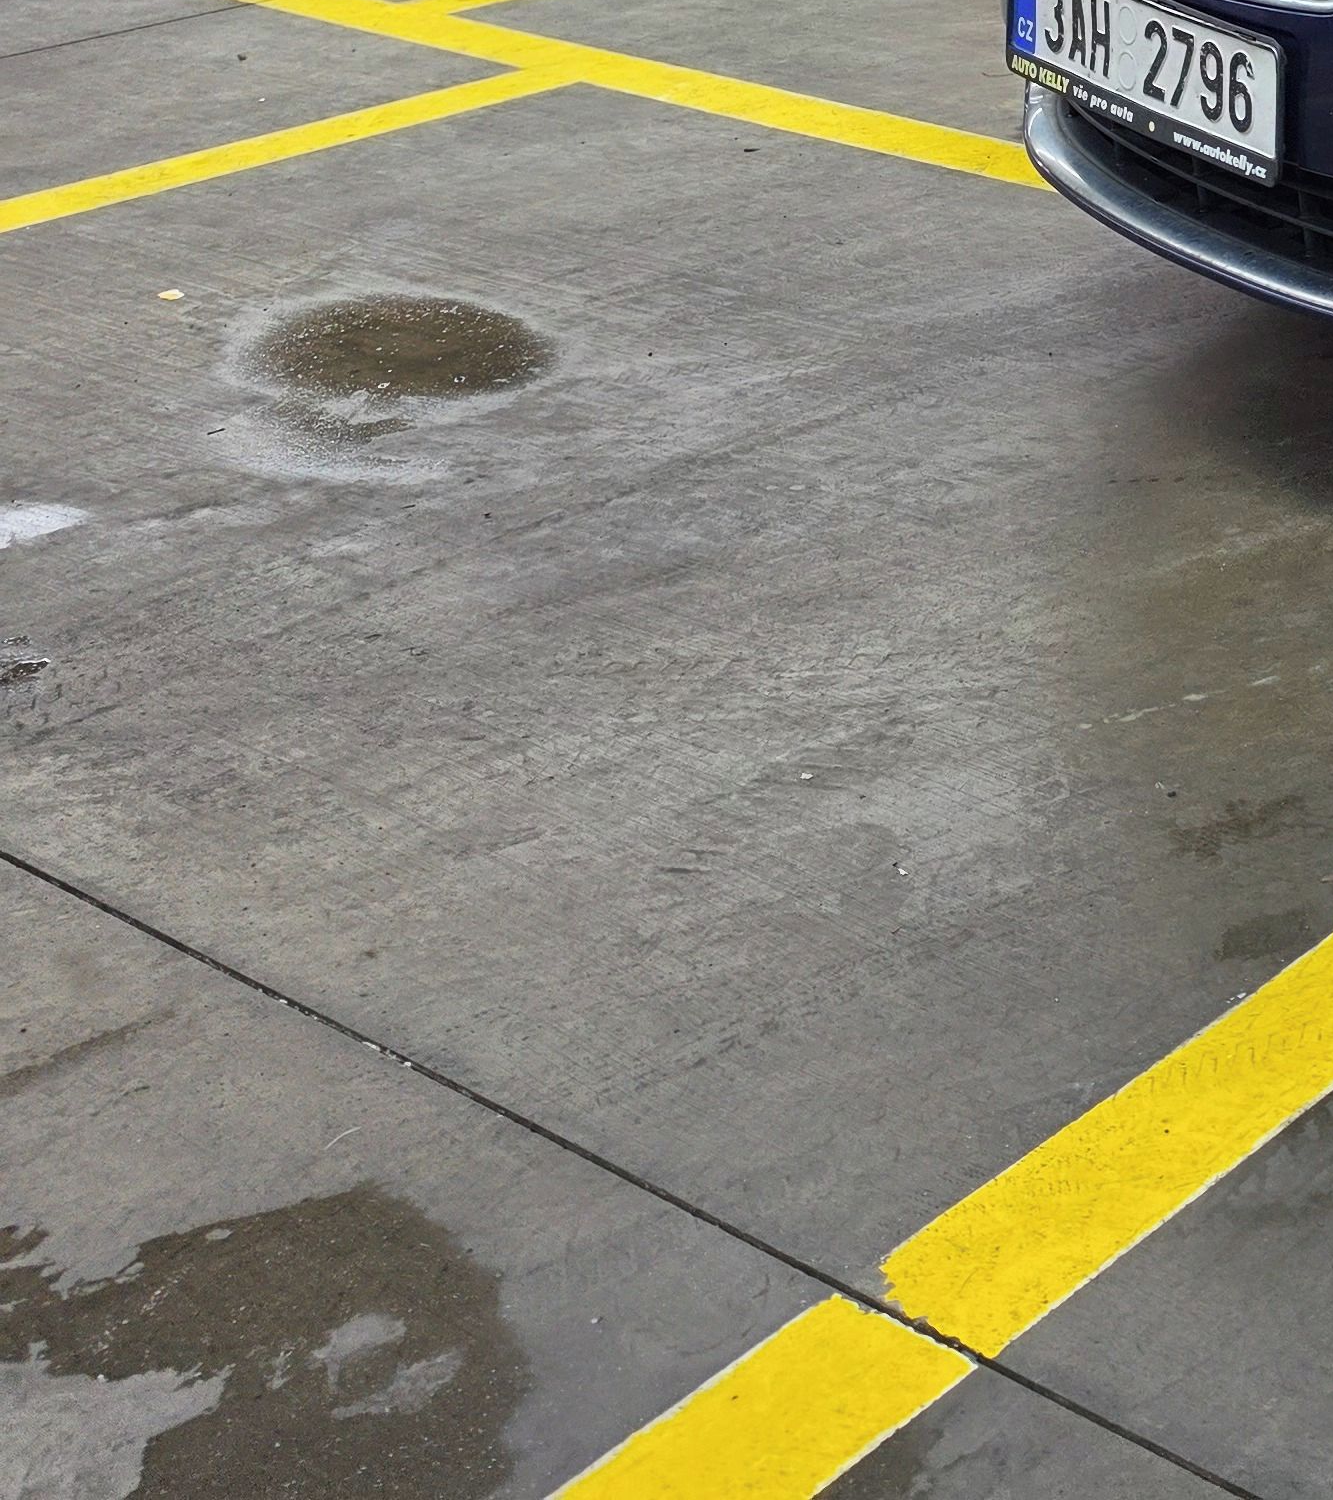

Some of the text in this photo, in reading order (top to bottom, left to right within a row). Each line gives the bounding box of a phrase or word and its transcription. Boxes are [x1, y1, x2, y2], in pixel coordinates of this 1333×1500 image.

[1017, 17, 1034, 42] CZ
[1011, 54, 1134, 123] AUTO KELLY vše pro auta
[1143, 19, 1256, 133] 2796
[1173, 130, 1268, 180] www.autokelly.cz
